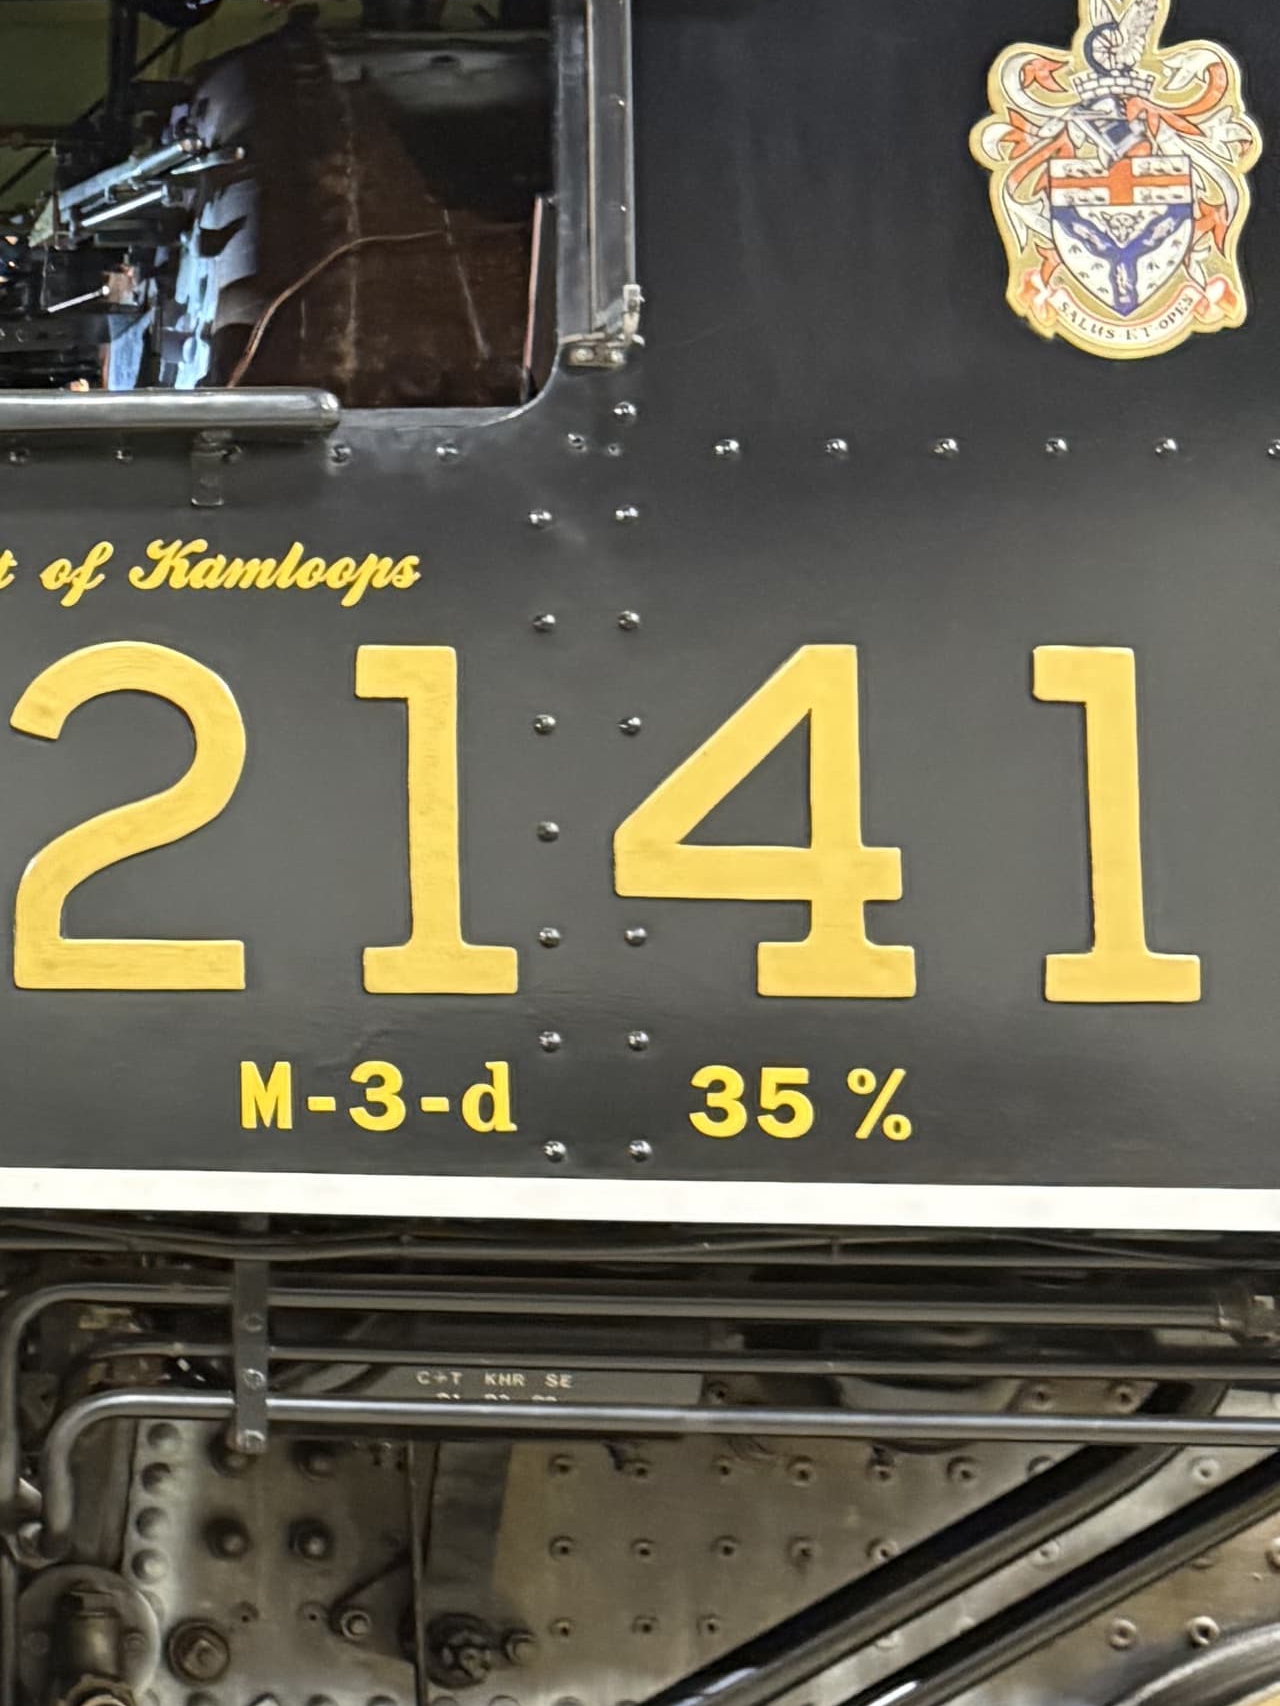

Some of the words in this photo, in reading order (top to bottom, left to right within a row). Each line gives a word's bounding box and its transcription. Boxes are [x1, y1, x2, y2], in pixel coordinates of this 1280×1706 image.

[40, 541, 114, 608] of
[128, 539, 420, 608] Kamloops
[10, 642, 1201, 1004] 2141
[239, 1060, 516, 1134] M-3-d
[688, 1065, 815, 1140] 35
[846, 1068, 912, 1142] %
